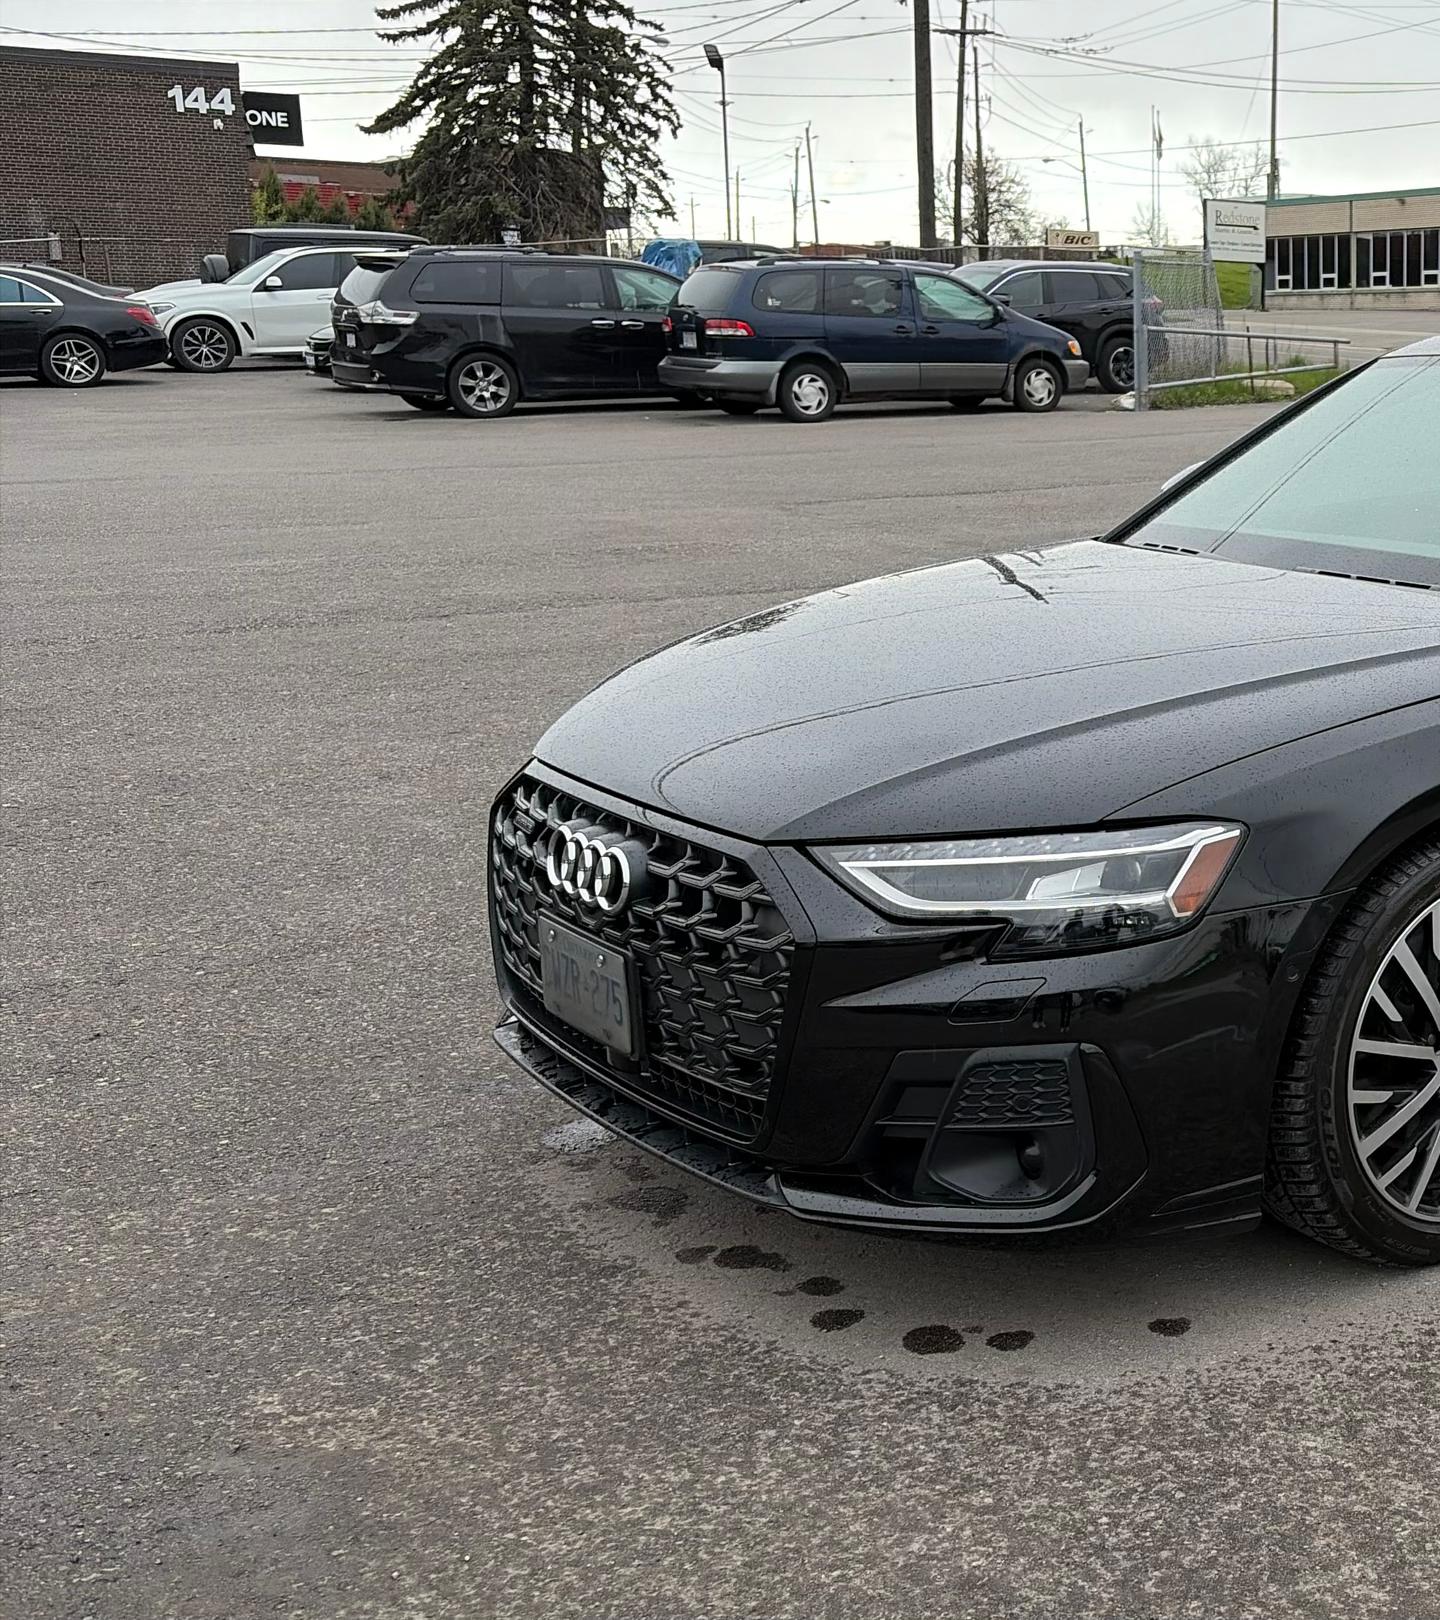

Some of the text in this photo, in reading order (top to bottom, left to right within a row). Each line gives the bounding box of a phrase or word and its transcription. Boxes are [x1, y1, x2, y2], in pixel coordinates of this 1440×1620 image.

[167, 84, 236, 115] 144
[245, 109, 289, 127] ONE
[1215, 209, 1260, 226] Redstone
